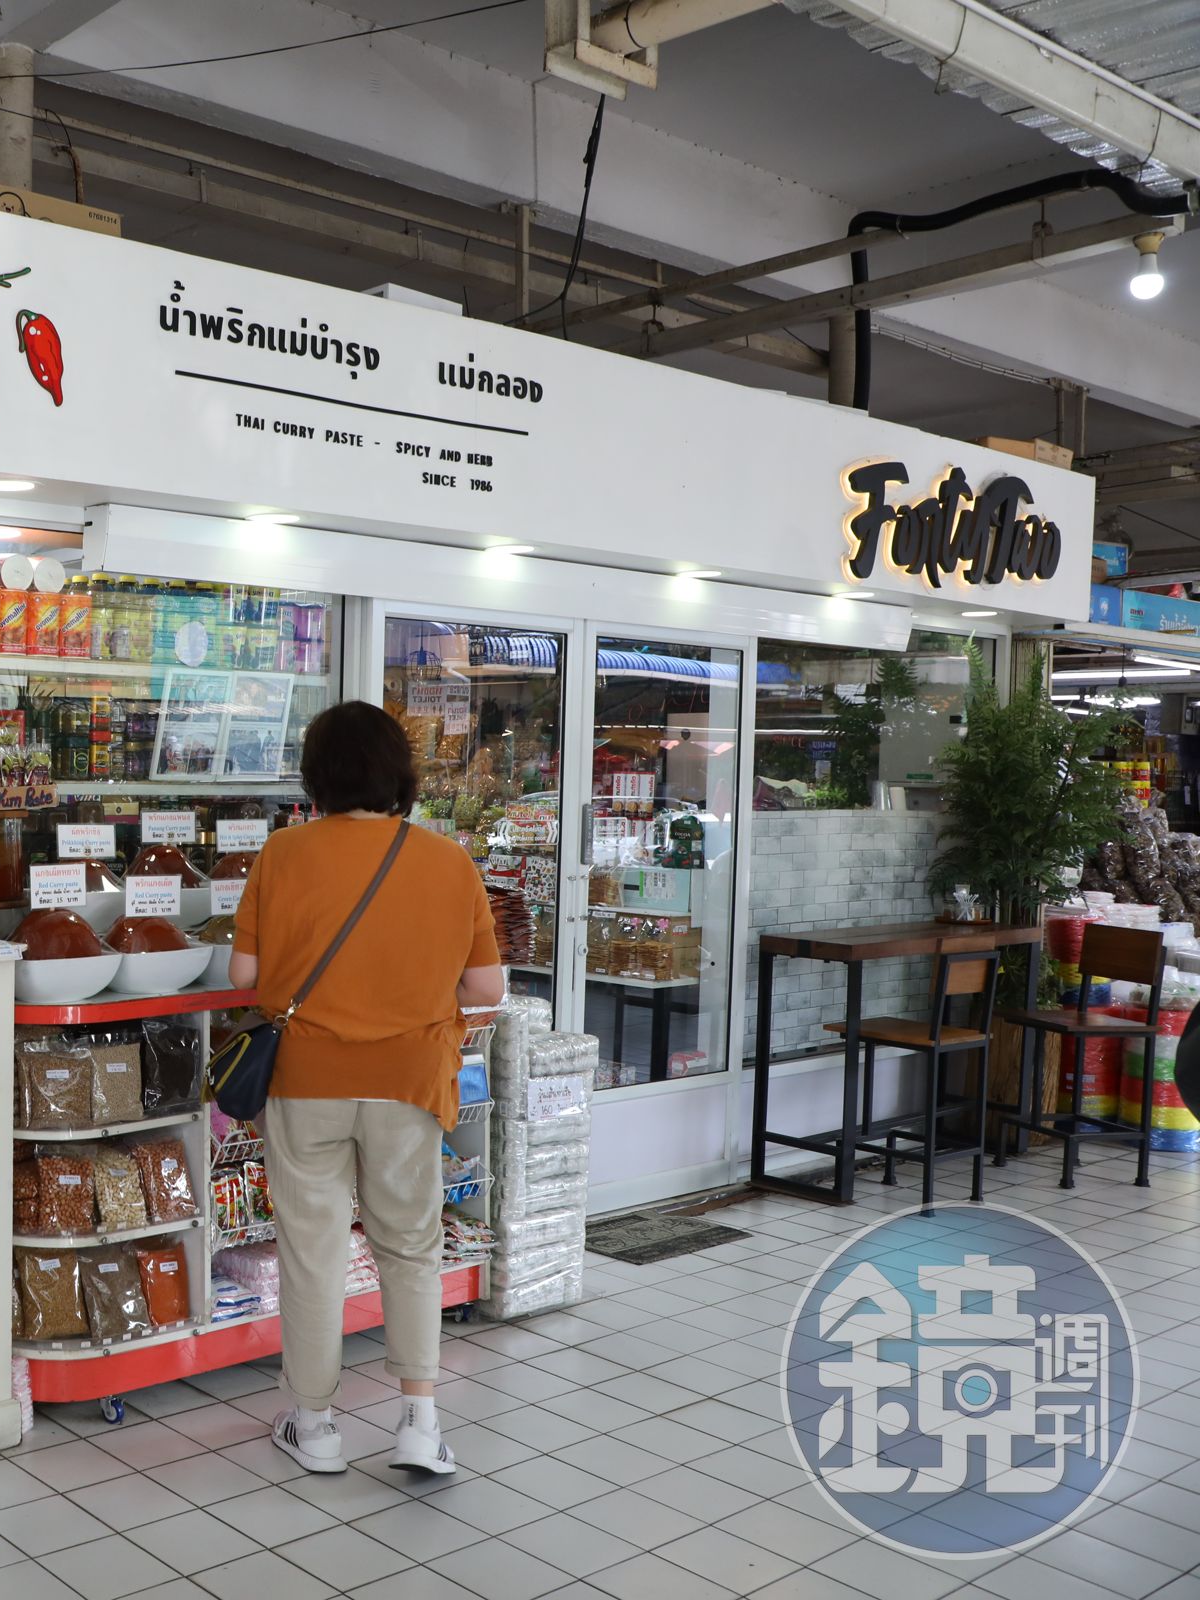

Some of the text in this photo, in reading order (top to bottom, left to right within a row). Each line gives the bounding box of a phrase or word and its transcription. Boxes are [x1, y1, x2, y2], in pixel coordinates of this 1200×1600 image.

[159, 280, 544, 403] น้ำพริกแม่บำรุง แม่กลอง
[235, 413, 265, 431] THAI
[273, 420, 316, 440] CURRY
[325, 430, 364, 447] PASTE
[395, 440, 431, 459] SPICY
[439, 449, 461, 463] AND
[467, 453, 493, 467] HERB
[422, 472, 493, 493] SINCE 1986
[49, 882, 65, 890] Curry
[65, 881, 79, 889] paste
